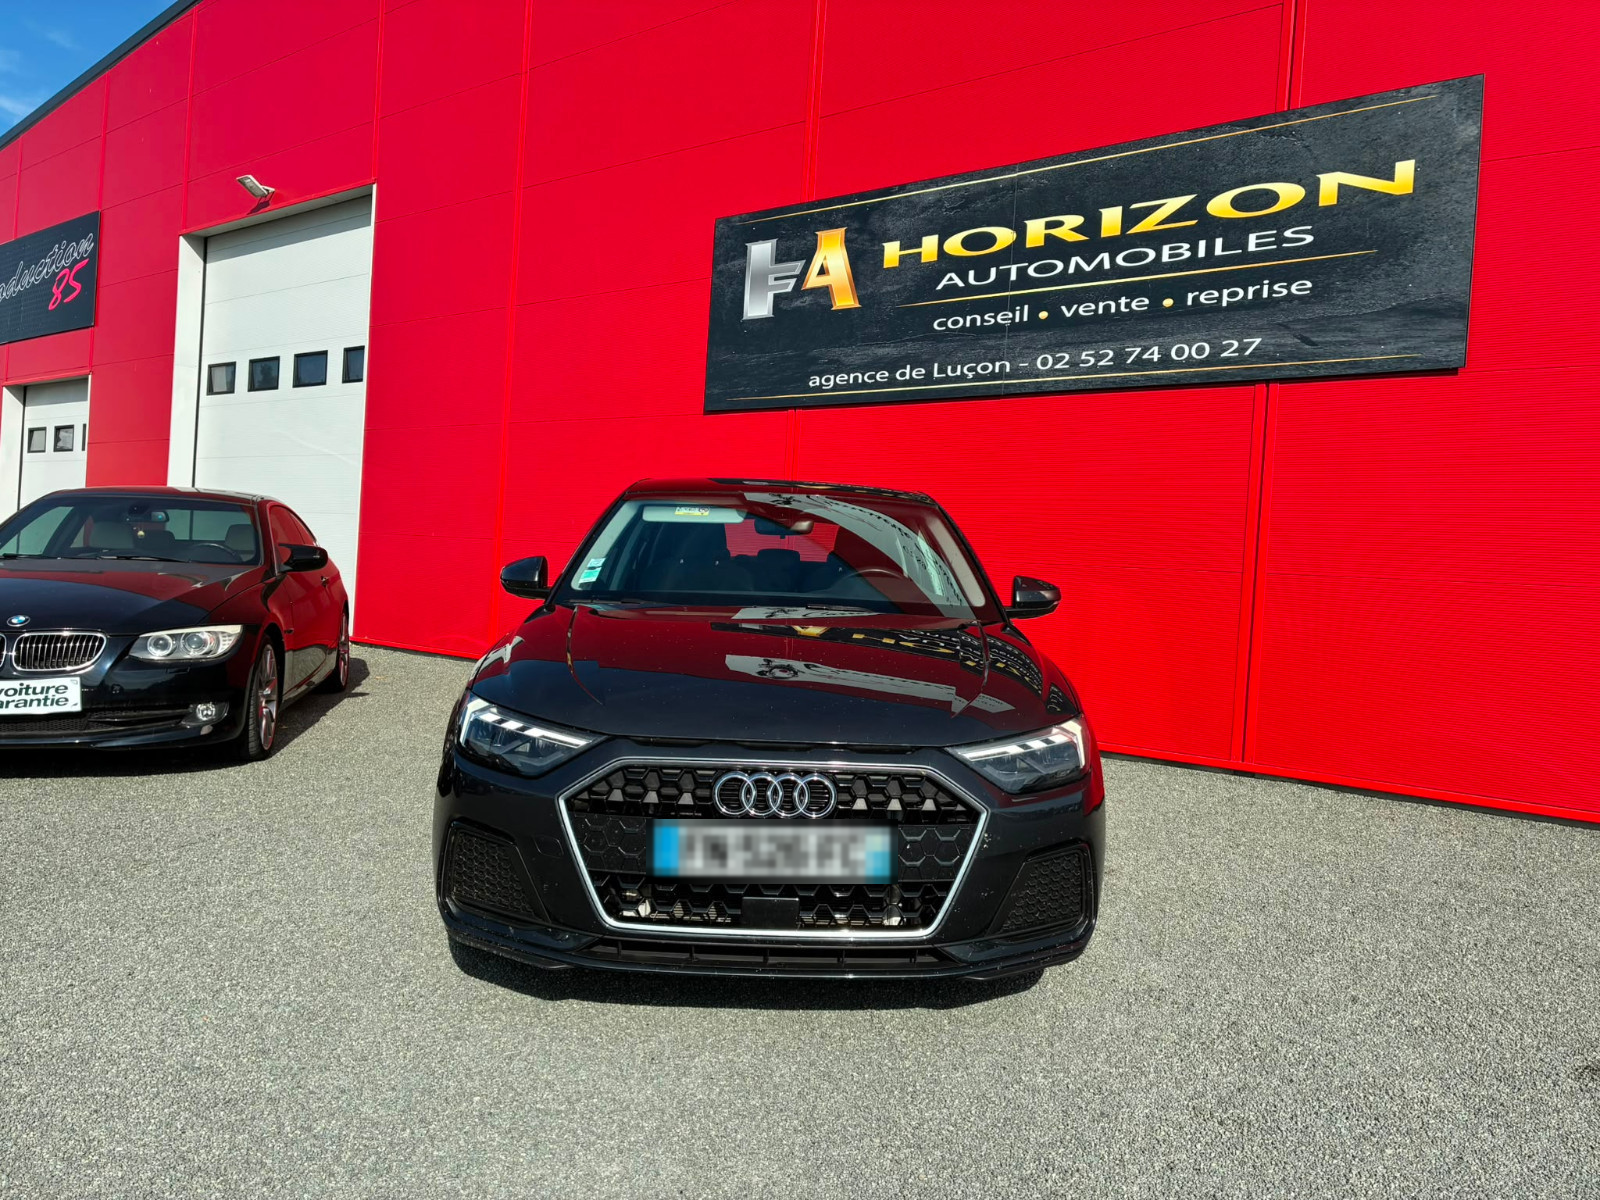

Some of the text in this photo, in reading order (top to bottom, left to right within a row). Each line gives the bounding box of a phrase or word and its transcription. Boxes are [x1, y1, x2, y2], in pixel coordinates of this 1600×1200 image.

[882, 158, 1416, 269] HORIZON
[48, 258, 90, 311] 85
[935, 225, 1316, 291] AUTOMOBILES
[932, 280, 1314, 331] conseil vente reprise
[808, 370, 890, 391] agence
[895, 364, 926, 382] de
[933, 360, 1012, 380] Luçon
[1035, 352, 1070, 371] 02
[1079, 349, 1114, 368] 52
[1125, 345, 1162, 365] 74
[1170, 341, 1211, 361] 00
[1220, 337, 1263, 359] 27
